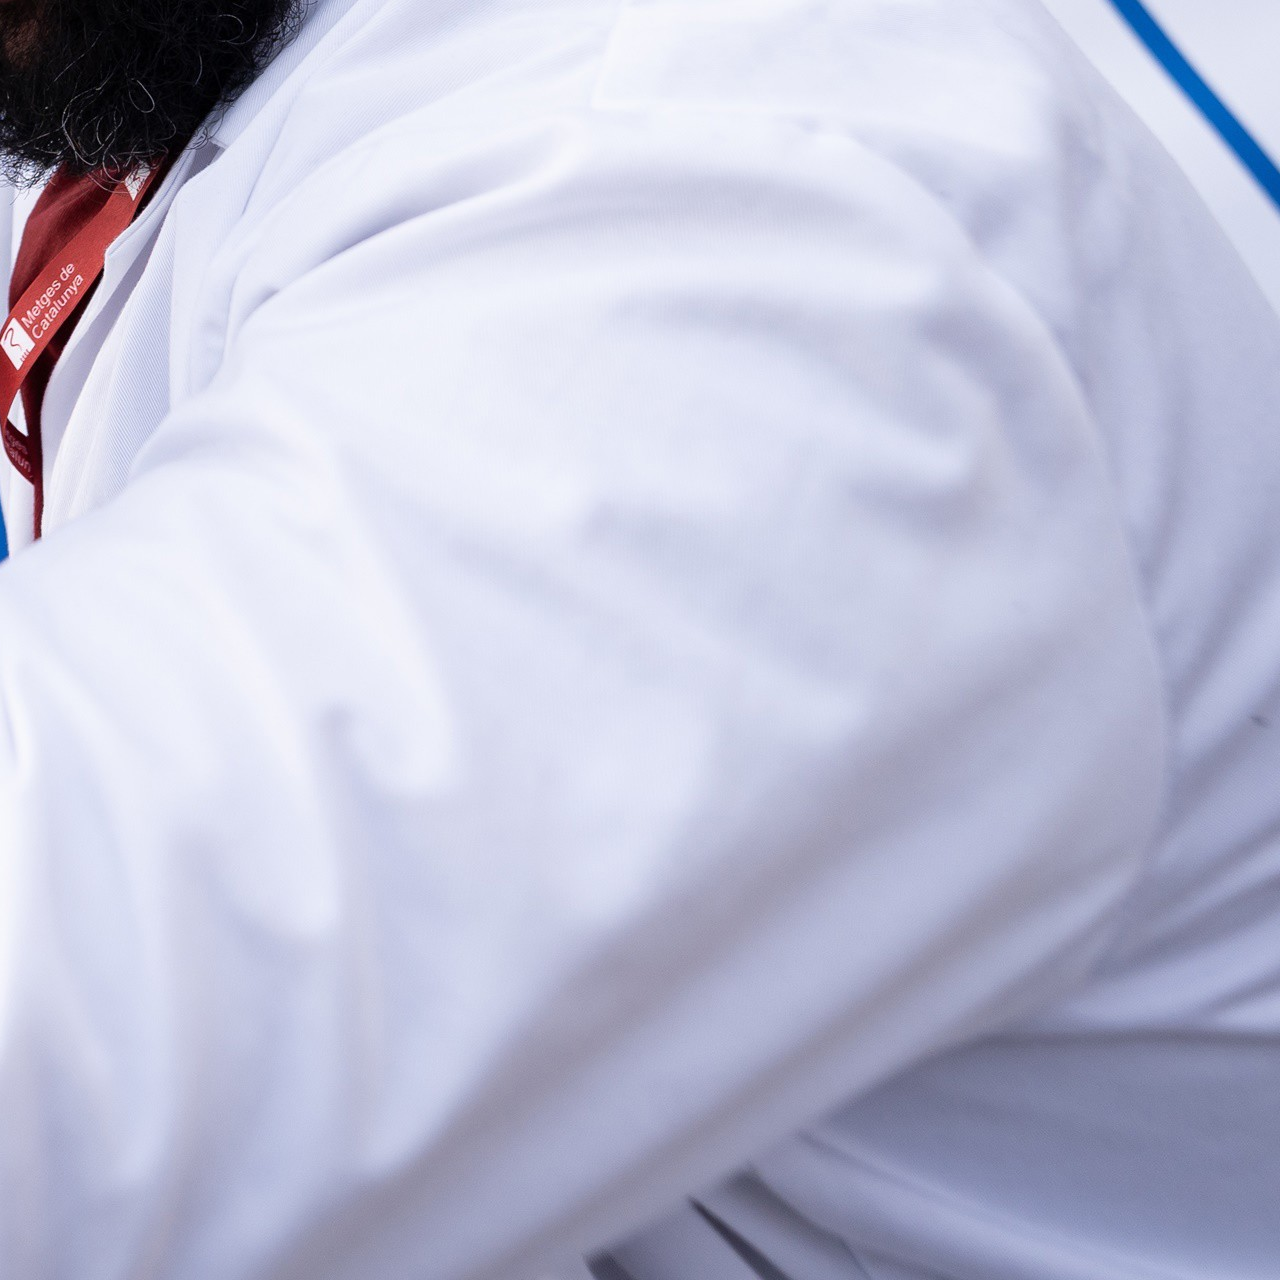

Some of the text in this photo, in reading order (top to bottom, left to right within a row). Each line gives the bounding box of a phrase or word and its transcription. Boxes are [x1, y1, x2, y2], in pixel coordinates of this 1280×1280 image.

[21, 261, 76, 329] Metges de
[31, 274, 85, 340] Catalunya
